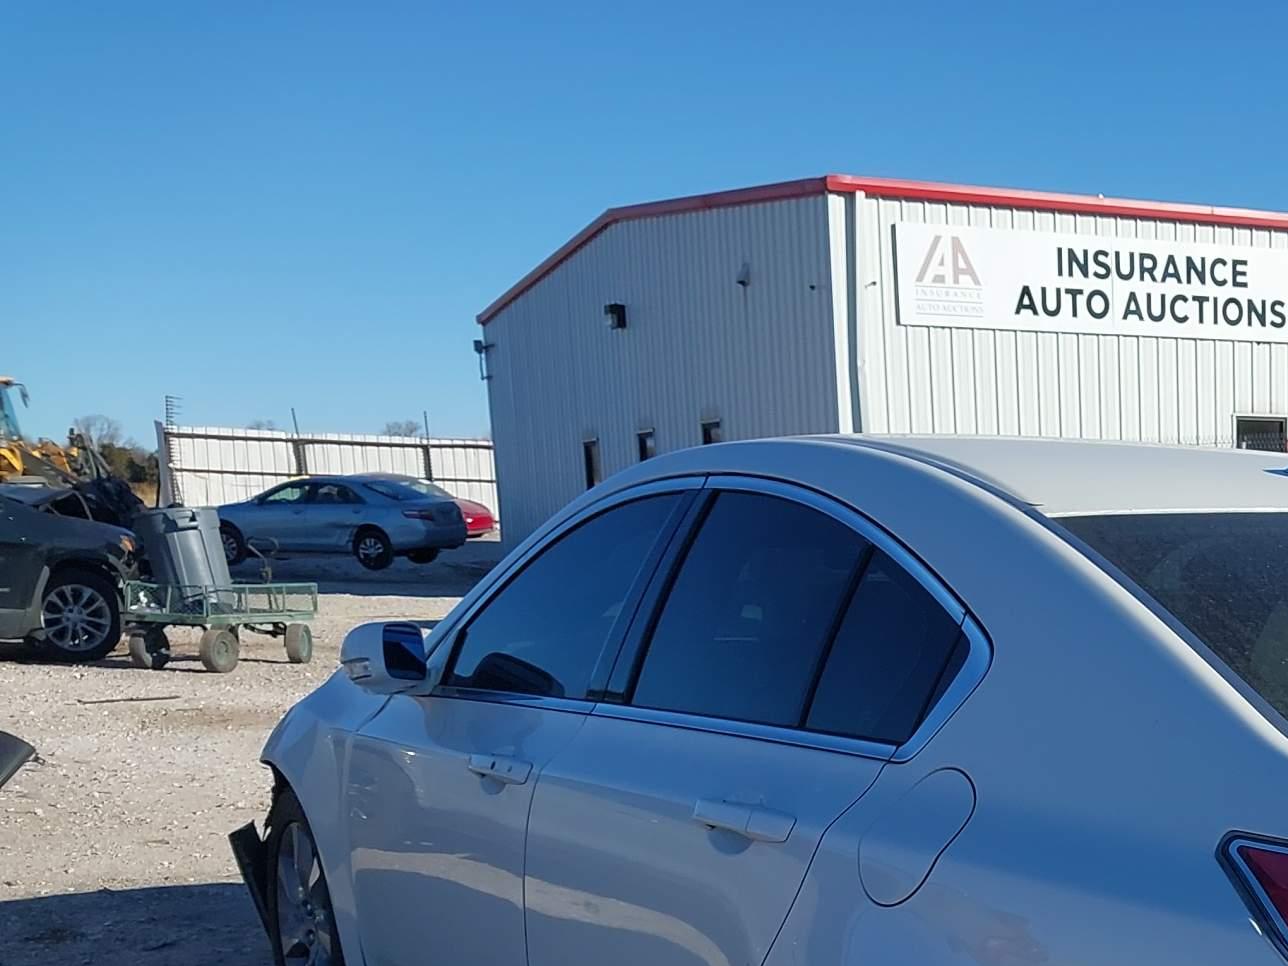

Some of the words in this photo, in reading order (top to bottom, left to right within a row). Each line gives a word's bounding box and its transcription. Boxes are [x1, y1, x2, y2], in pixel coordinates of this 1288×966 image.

[1057, 247, 1249, 288] INSURANCE
[1015, 285, 1110, 320] AUTO
[1122, 291, 1287, 328] AUCTIONS
